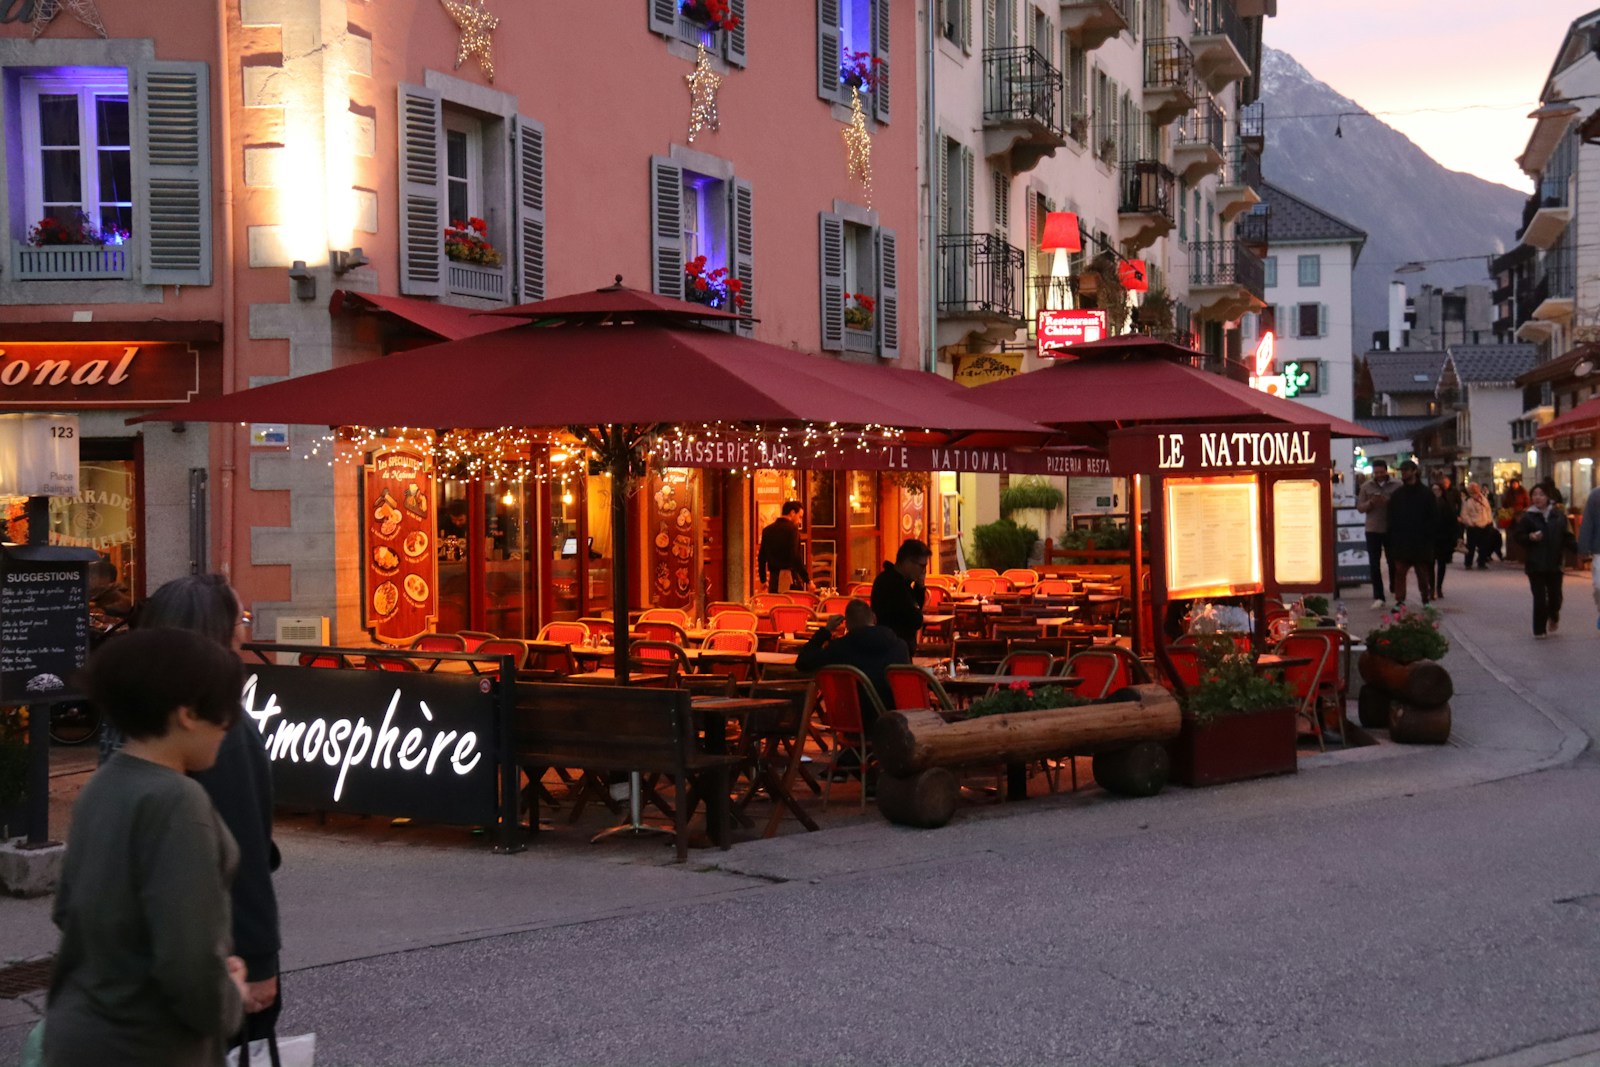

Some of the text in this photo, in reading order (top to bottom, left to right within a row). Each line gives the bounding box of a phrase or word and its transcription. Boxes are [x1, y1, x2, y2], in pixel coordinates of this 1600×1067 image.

[1045, 316, 1100, 326] Restaurant
[1044, 325, 1083, 336] Chinois
[0, 346, 140, 386] onal
[50, 426, 74, 438] 123
[662, 439, 788, 465] BRASSERIE BAR
[1157, 430, 1317, 469] LE NATIONAL
[888, 446, 1008, 472] LE NATIONAL
[1047, 455, 1082, 473] PIZZERIA
[49, 472, 74, 481] Place
[43, 484, 74, 493] Balmat
[7, 571, 80, 583] SUGGESTIONS
